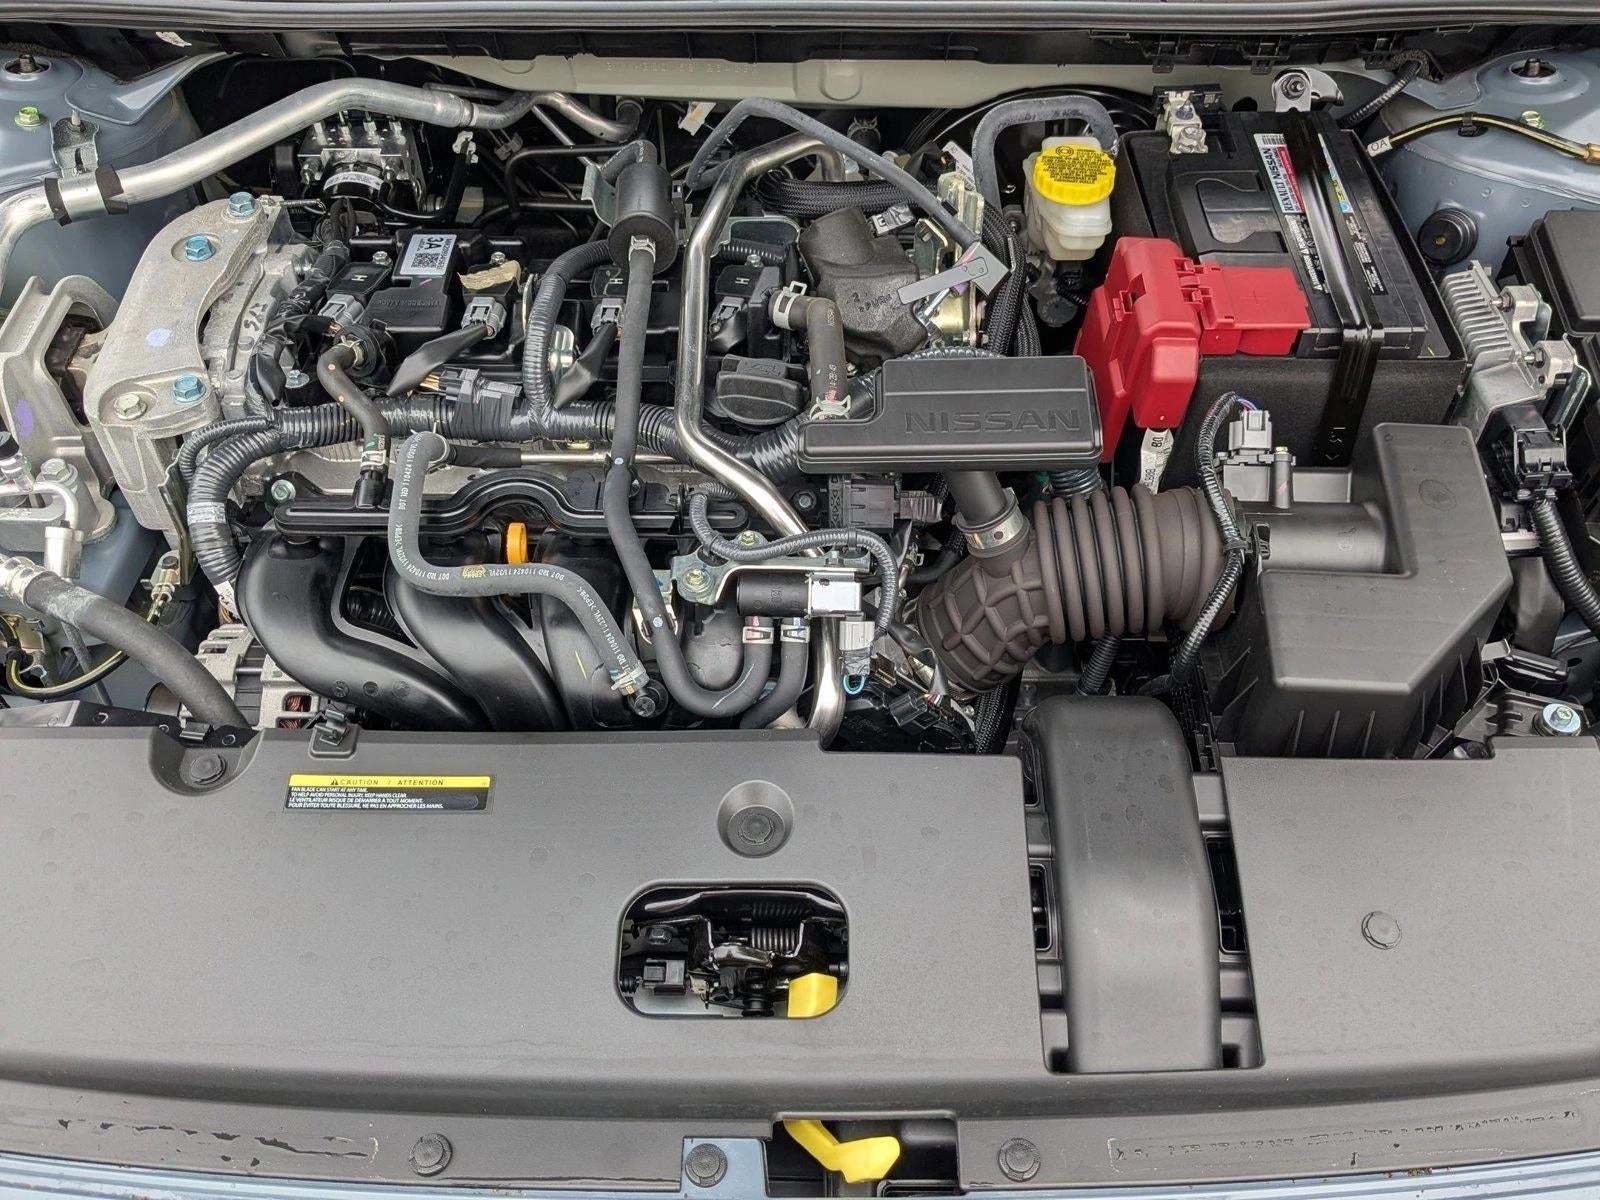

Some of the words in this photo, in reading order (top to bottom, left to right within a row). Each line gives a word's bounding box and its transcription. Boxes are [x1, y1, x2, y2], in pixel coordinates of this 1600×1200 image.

[1262, 148, 1281, 180] NISSAN
[1275, 181, 1294, 212] RENAULT
[425, 238, 443, 250] 3A
[905, 408, 1080, 433] NISSAN
